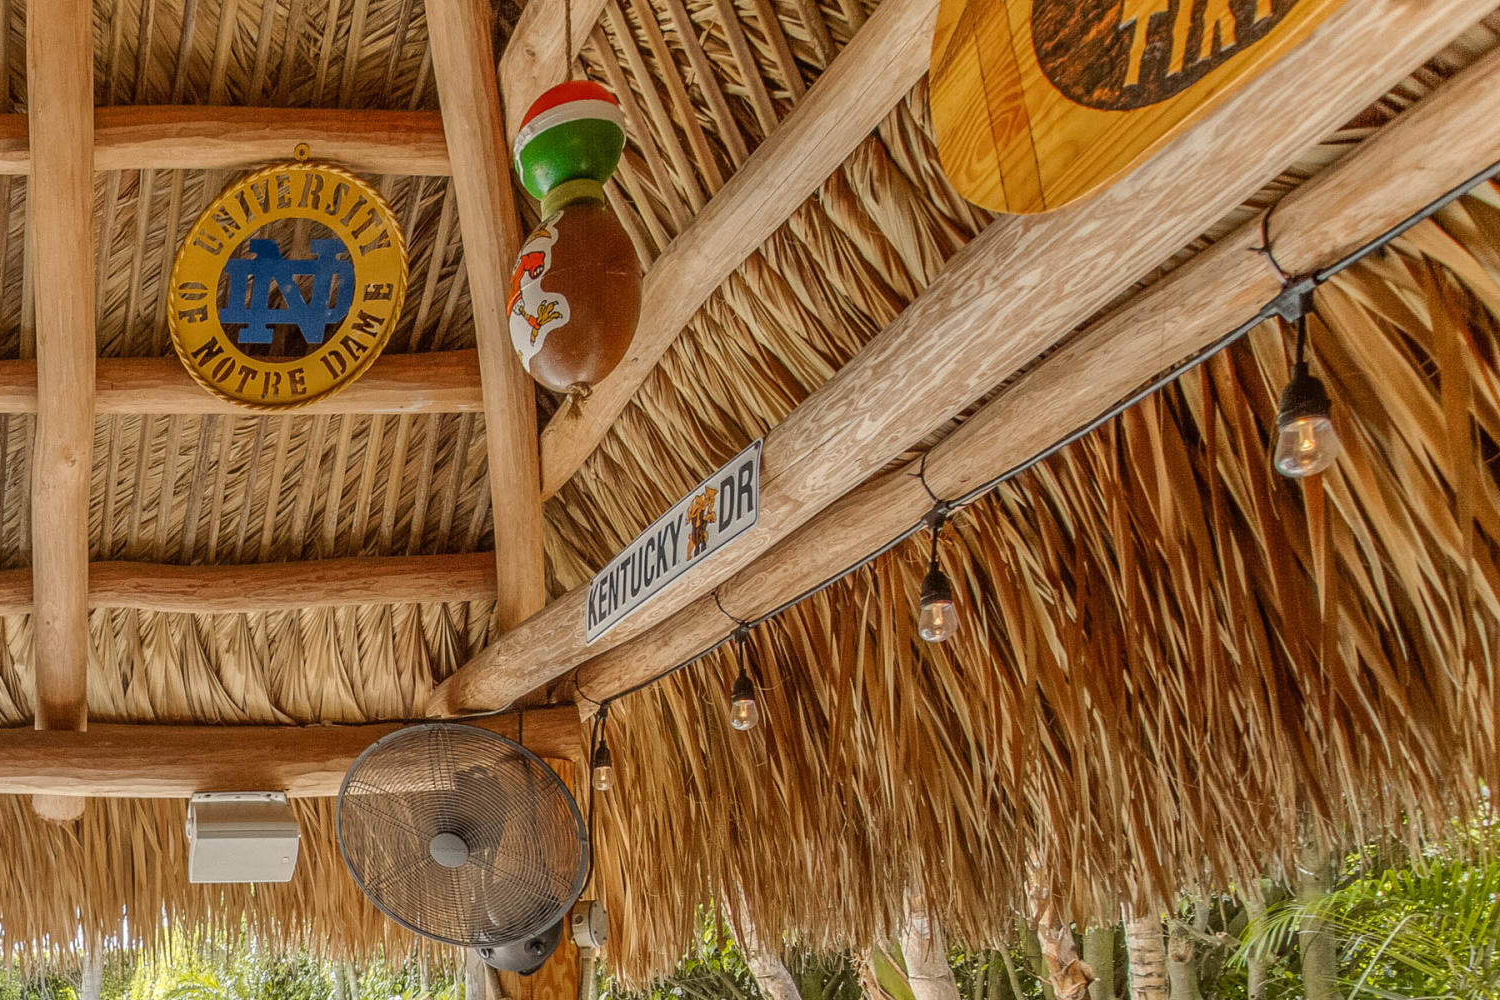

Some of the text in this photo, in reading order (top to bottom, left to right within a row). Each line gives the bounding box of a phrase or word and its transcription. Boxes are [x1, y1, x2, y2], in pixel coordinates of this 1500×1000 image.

[1119, 0, 1272, 87] TIK
[194, 173, 391, 256] UNIVERSITY
[178, 281, 208, 323] OF
[191, 283, 393, 399] NOTRE DAME
[588, 460, 754, 631] KENTUCKY DR
